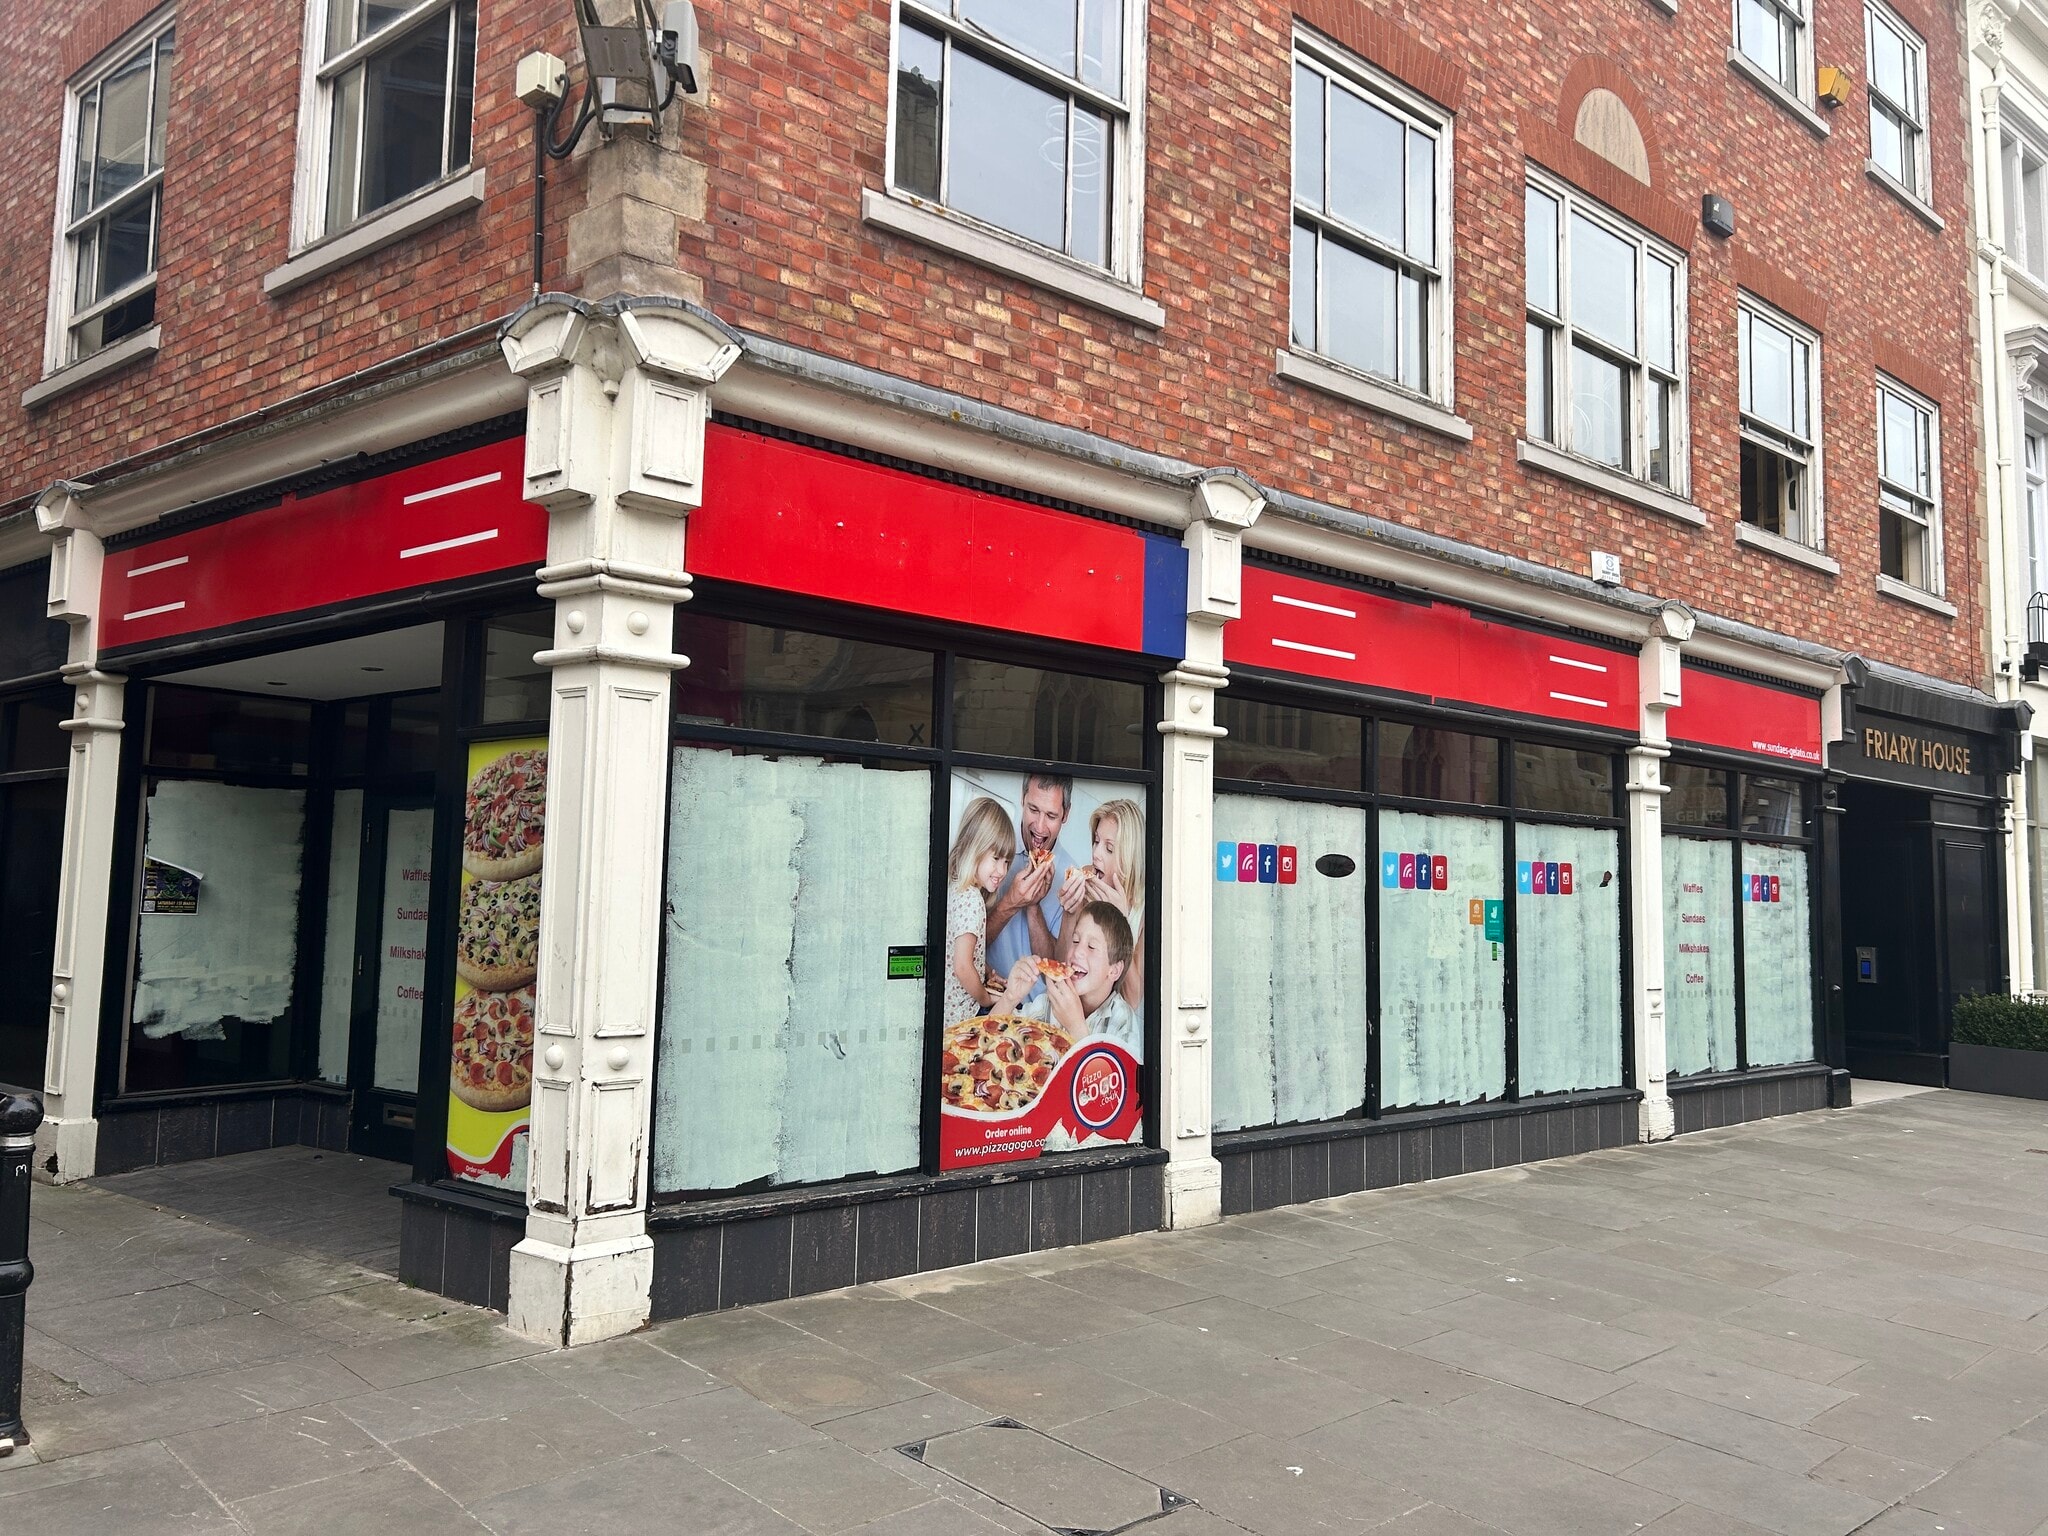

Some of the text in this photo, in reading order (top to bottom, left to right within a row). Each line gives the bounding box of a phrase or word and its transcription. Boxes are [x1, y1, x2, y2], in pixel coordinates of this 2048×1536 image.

[1751, 740, 1820, 760] www.sundaes-gelato.co.uk
[1865, 727, 1971, 775] FRIARY HOUSE
[402, 869, 431, 881] Waffles
[1683, 883, 1704, 894] Waffles
[397, 907, 429, 921] Sundae
[1681, 913, 1706, 923] Sundaes
[390, 945, 427, 960] Milkshak
[1679, 943, 1710, 953] Milkshakes
[1685, 973, 1704, 984] Coffee
[397, 985, 424, 1000] Coffee
[1081, 1070, 1102, 1088] Pizza
[984, 1124, 1032, 1139] Order online
